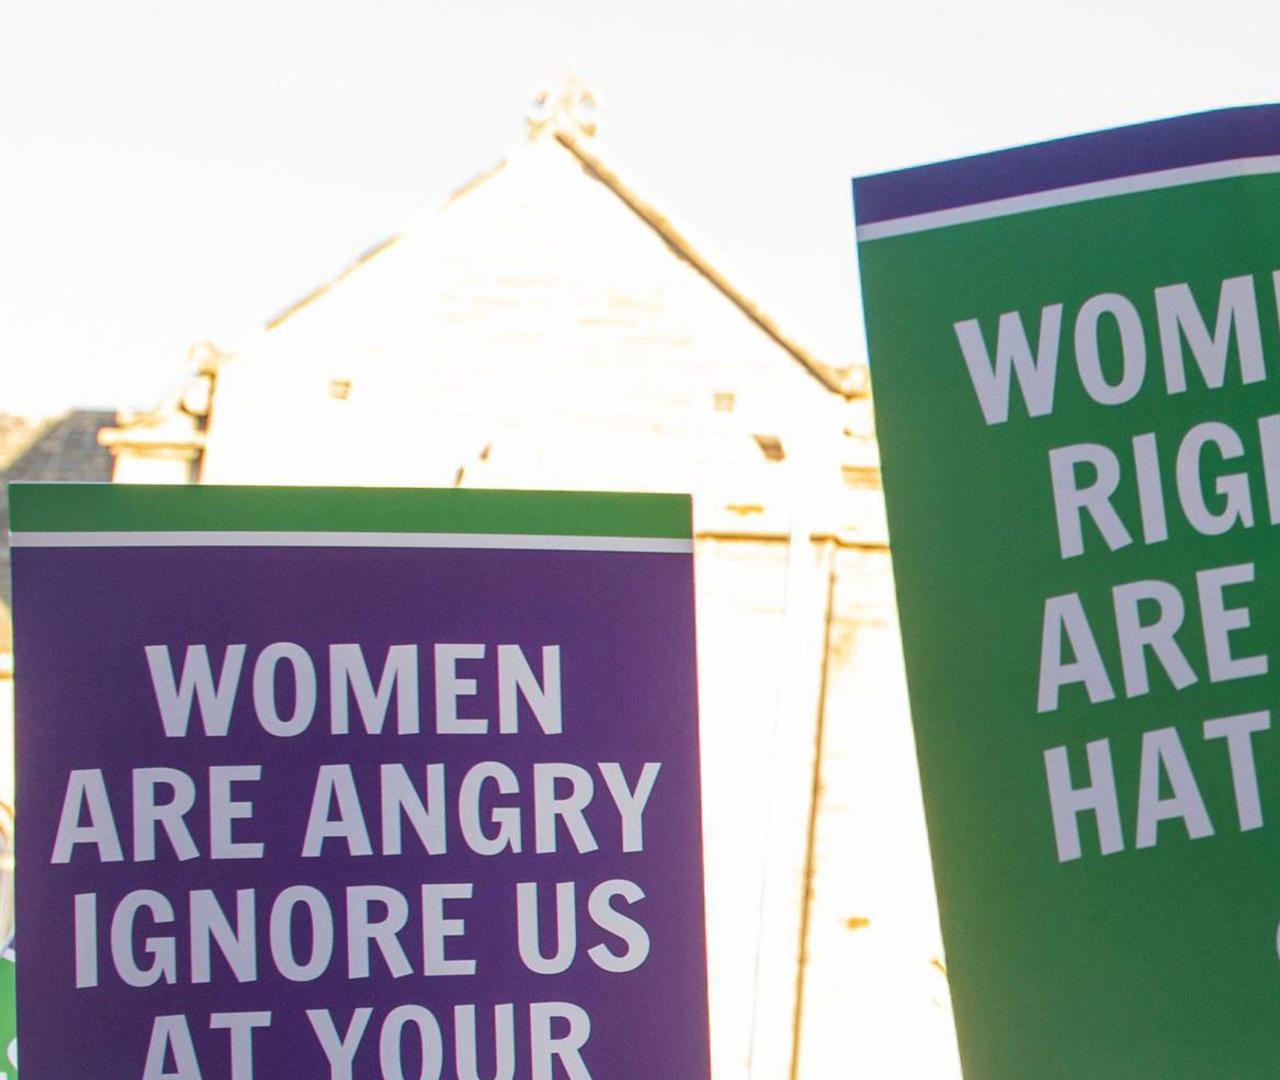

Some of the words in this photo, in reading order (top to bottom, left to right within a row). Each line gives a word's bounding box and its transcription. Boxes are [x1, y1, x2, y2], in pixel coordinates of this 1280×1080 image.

[144, 642, 563, 737] WOMEN
[1037, 563, 1268, 713] ARE
[50, 765, 264, 864] ARE
[301, 760, 662, 857] ANGRY
[75, 883, 477, 989] IGNORE
[516, 878, 652, 976] US
